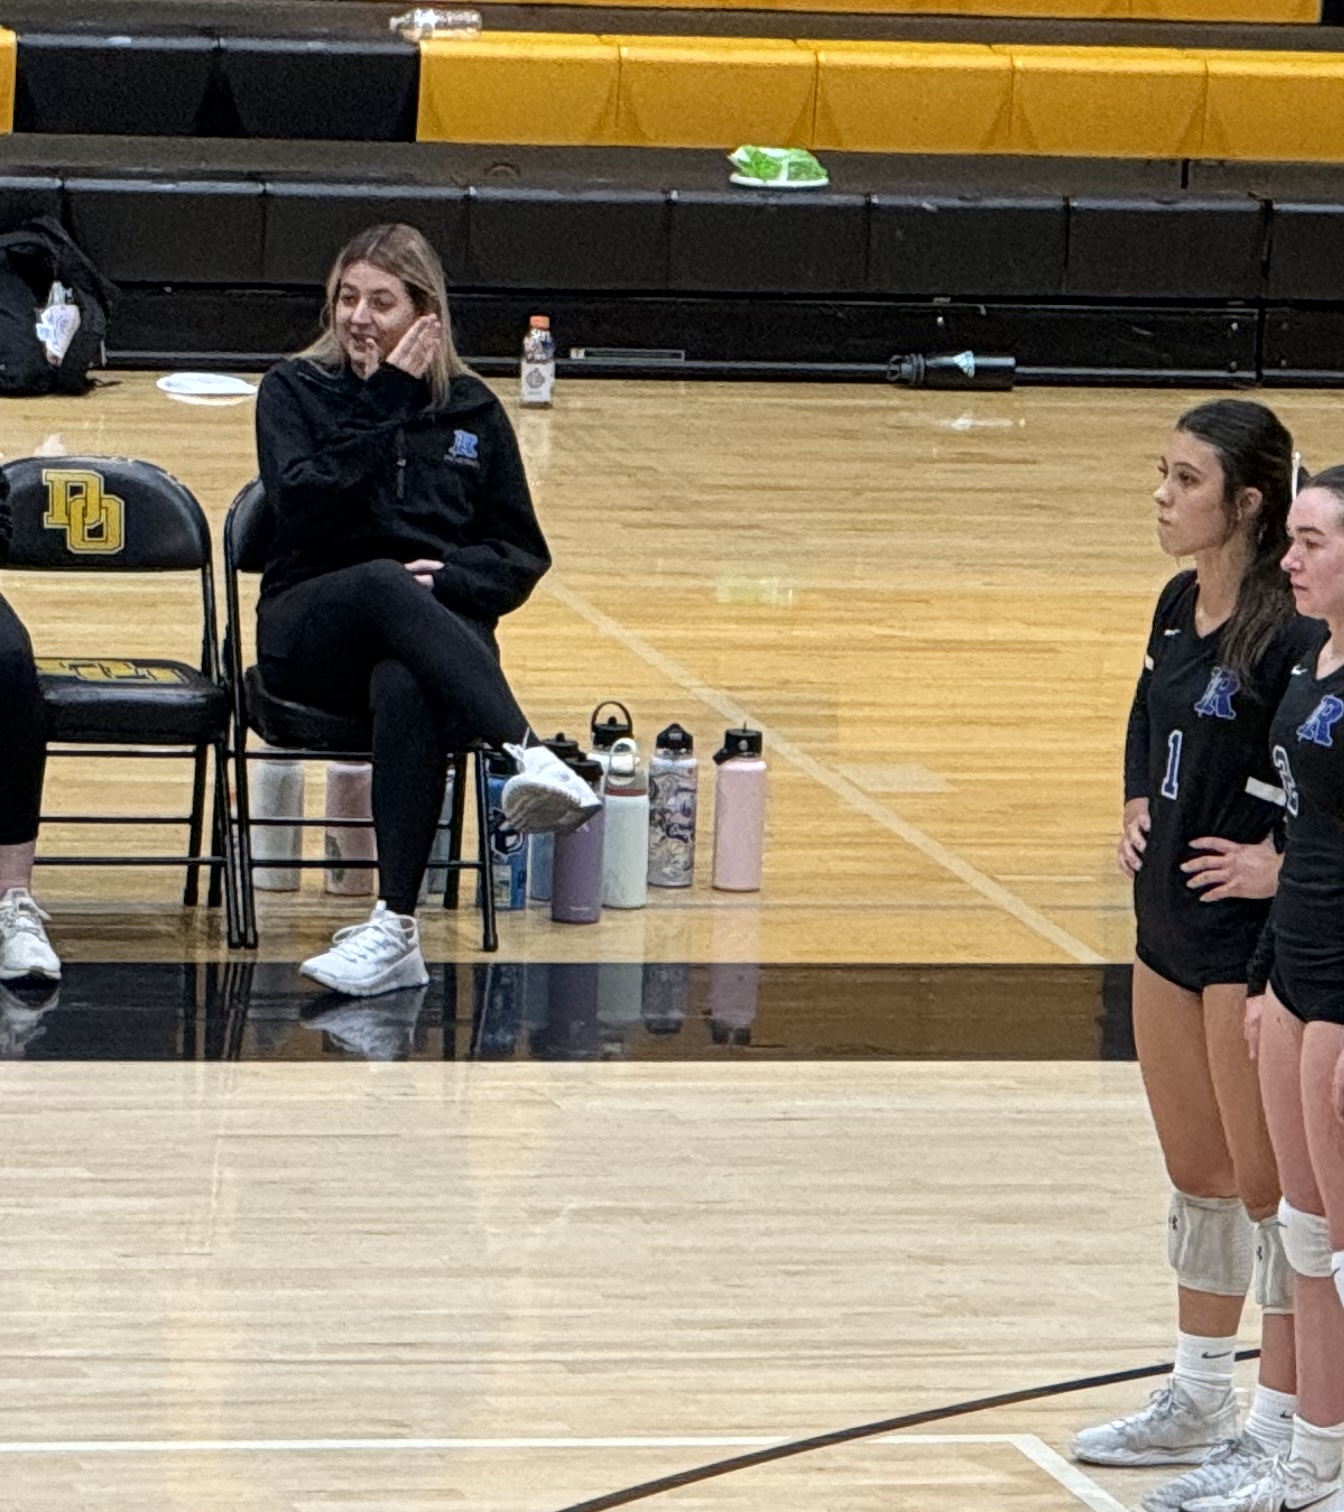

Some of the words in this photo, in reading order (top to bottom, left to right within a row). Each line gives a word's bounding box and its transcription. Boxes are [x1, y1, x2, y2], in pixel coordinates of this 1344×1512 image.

[1194, 665, 1240, 720] R
[1297, 694, 1344, 747] R
[1161, 730, 1183, 800] 1
[1273, 745, 1299, 818] 2
